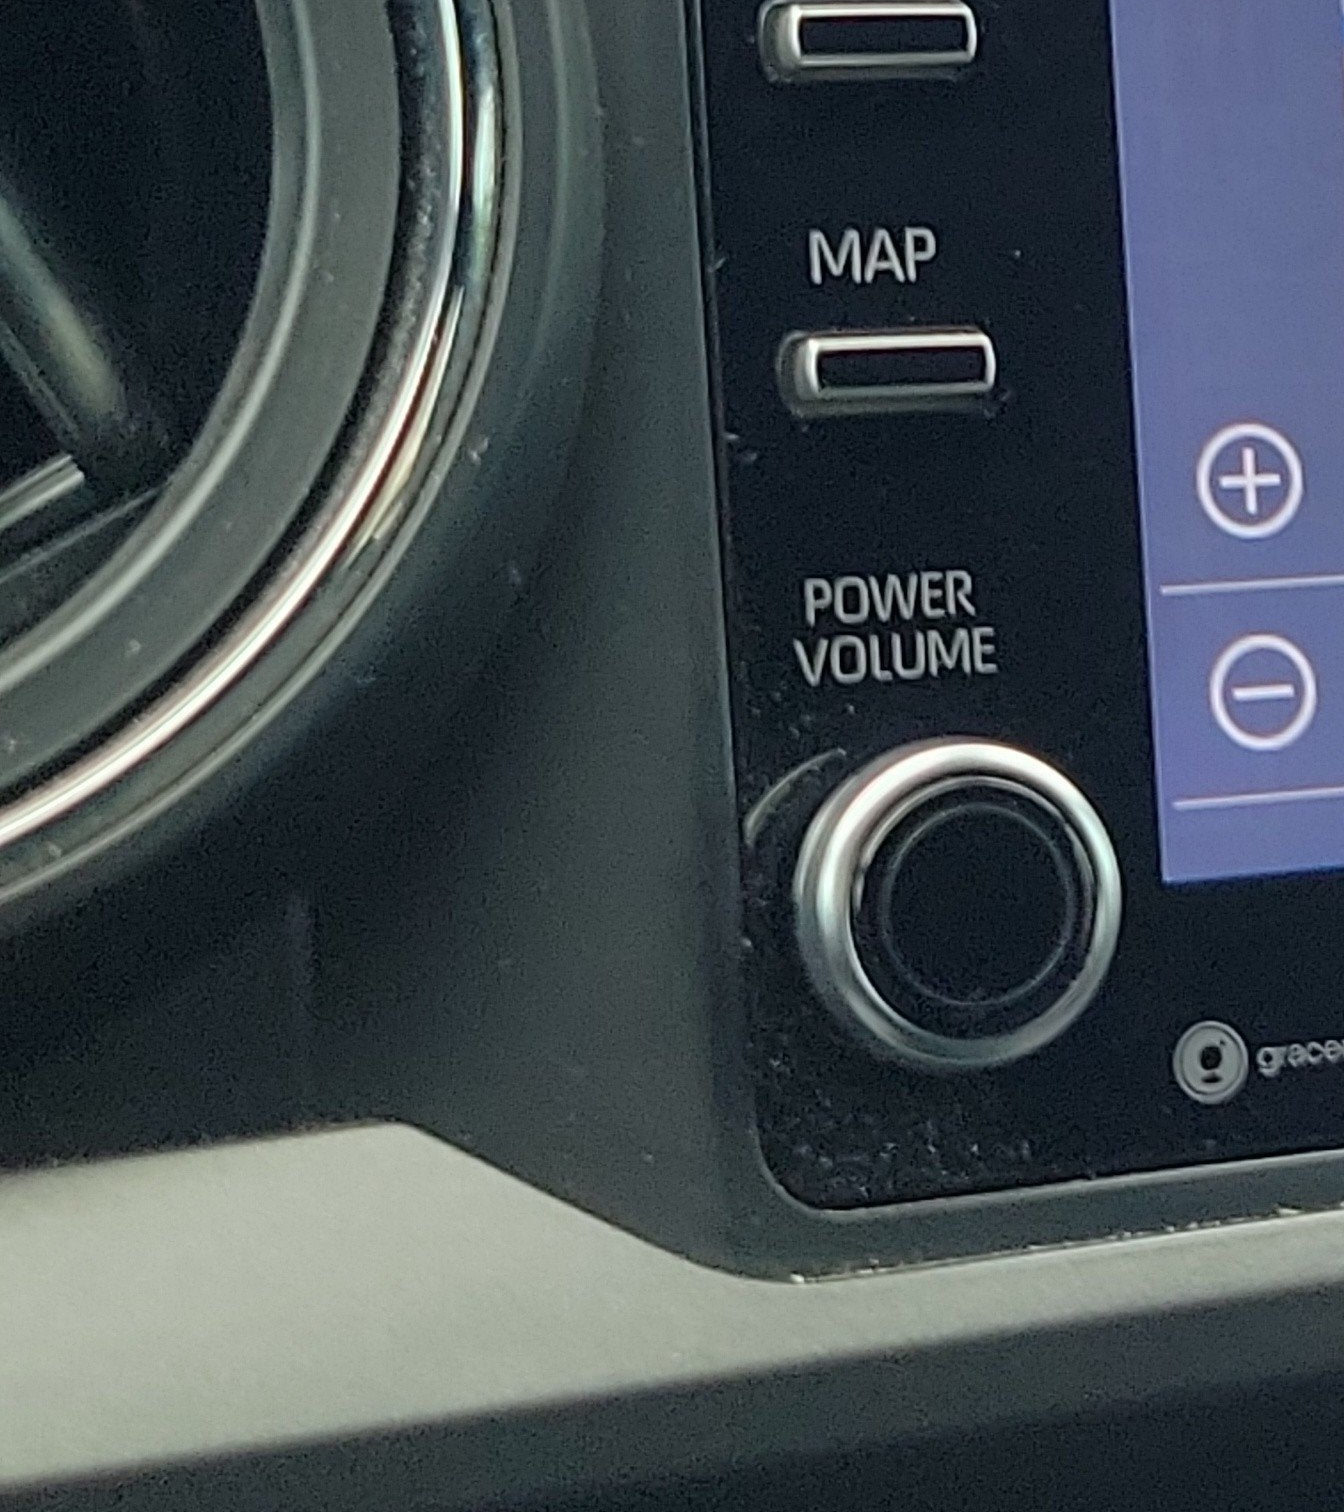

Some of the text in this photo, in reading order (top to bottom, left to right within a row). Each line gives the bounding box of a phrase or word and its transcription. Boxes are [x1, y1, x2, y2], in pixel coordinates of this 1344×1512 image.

[808, 227, 937, 285] MAP
[803, 570, 976, 627] POWER
[793, 627, 999, 687] VOLUME
